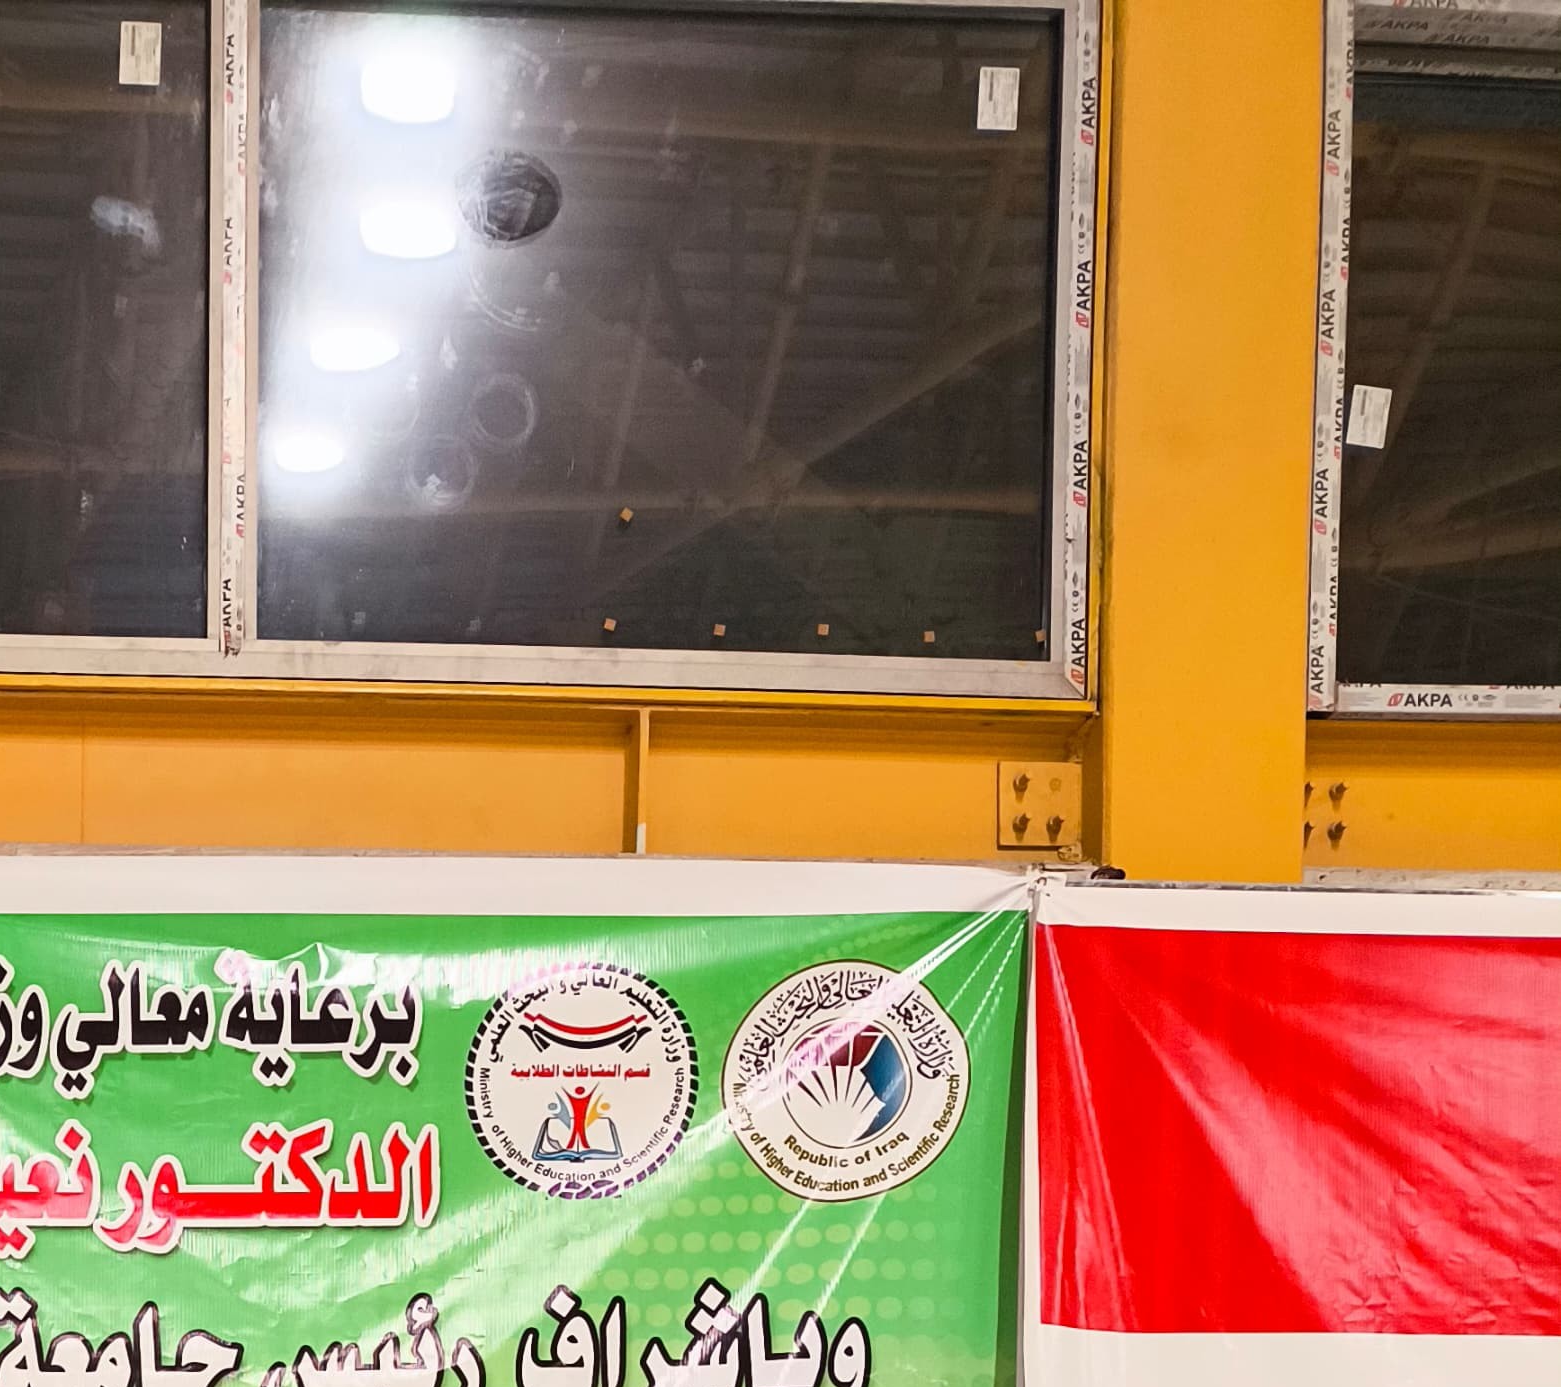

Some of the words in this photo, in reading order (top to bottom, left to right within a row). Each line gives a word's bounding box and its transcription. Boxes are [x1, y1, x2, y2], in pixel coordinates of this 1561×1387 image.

[1082, 76, 1098, 129] AKPA
[1326, 109, 1342, 160] AKPA
[1076, 260, 1092, 311] AKPA
[1321, 288, 1337, 340] AKPA
[1073, 439, 1088, 491] AKPA
[1314, 467, 1329, 519] AKPA
[1072, 617, 1086, 668] AKPA
[1310, 645, 1324, 695] AKPA
[1403, 692, 1453, 708] AKPA
[54, 966, 210, 1091] معالي
[224, 952, 419, 1081] برعاية
[479, 1067, 495, 1119] Ministry
[492, 1125, 503, 1138] of
[500, 1134, 534, 1170] Higher
[534, 1162, 596, 1182] Education
[598, 1164, 622, 1180] and
[623, 1125, 670, 1168] Scientific
[662, 1066, 685, 1127] Research
[749, 1131, 765, 1146] of
[759, 1142, 795, 1178] Higher
[862, 1168, 888, 1187] and
[889, 1132, 940, 1177] Scientific
[933, 1073, 961, 1133] Research
[783, 1133, 849, 1169] Republic
[854, 1147, 872, 1166] of
[876, 1130, 910, 1159] Iraq
[98, 1123, 438, 1248] الدكتور
